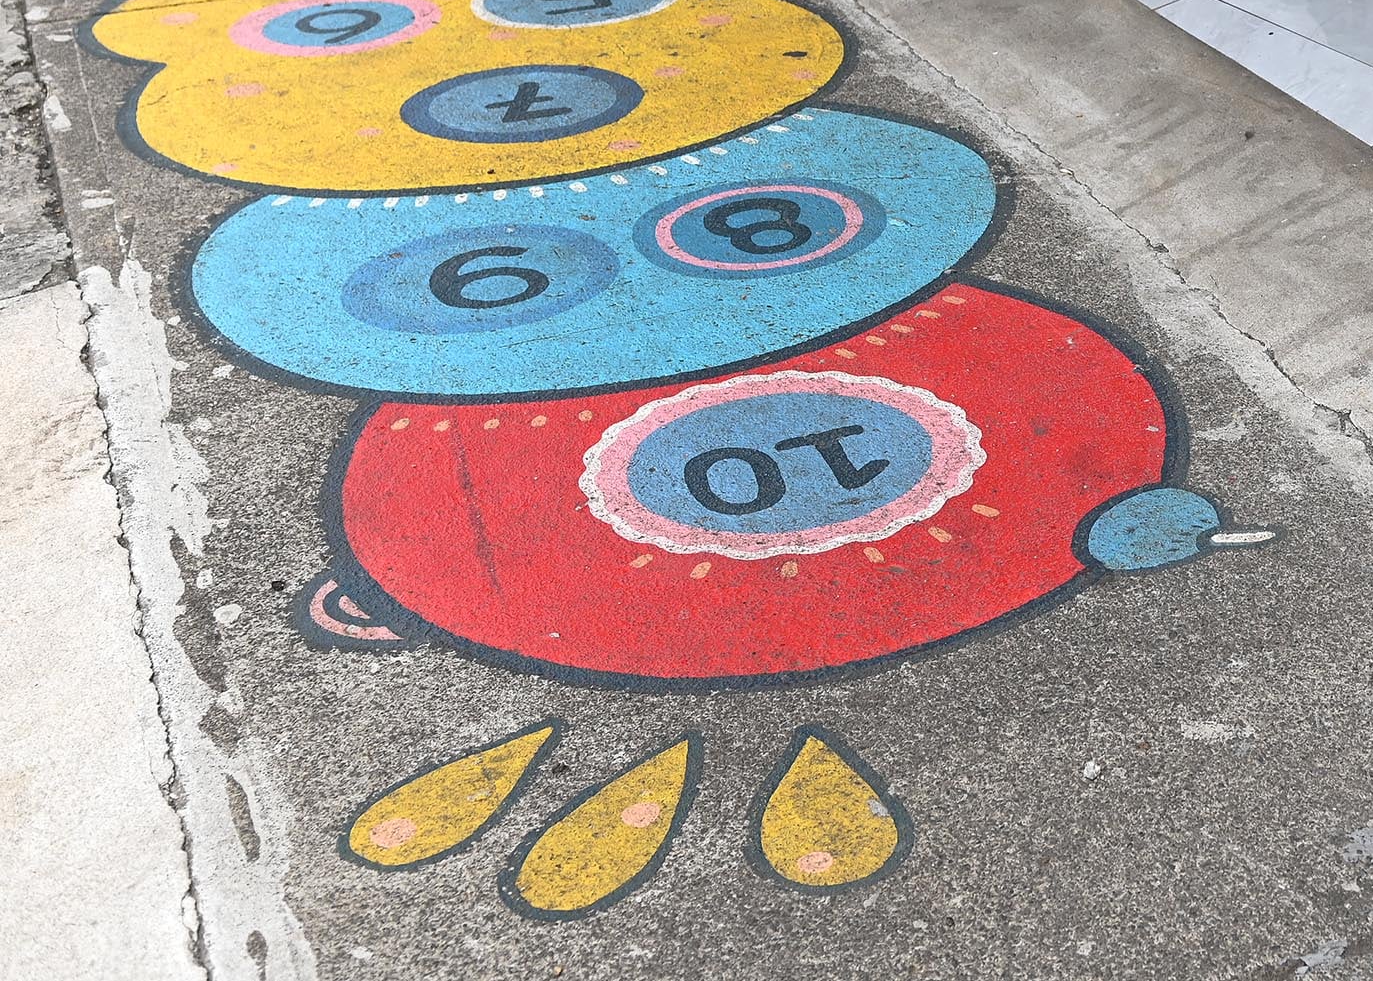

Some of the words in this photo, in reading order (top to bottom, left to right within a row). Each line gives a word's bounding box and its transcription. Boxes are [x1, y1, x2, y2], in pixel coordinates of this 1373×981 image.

[294, 8, 382, 46] 6
[484, 81, 574, 126] 7
[702, 197, 813, 255] 8
[428, 245, 550, 311] 9
[683, 424, 891, 517] 10
